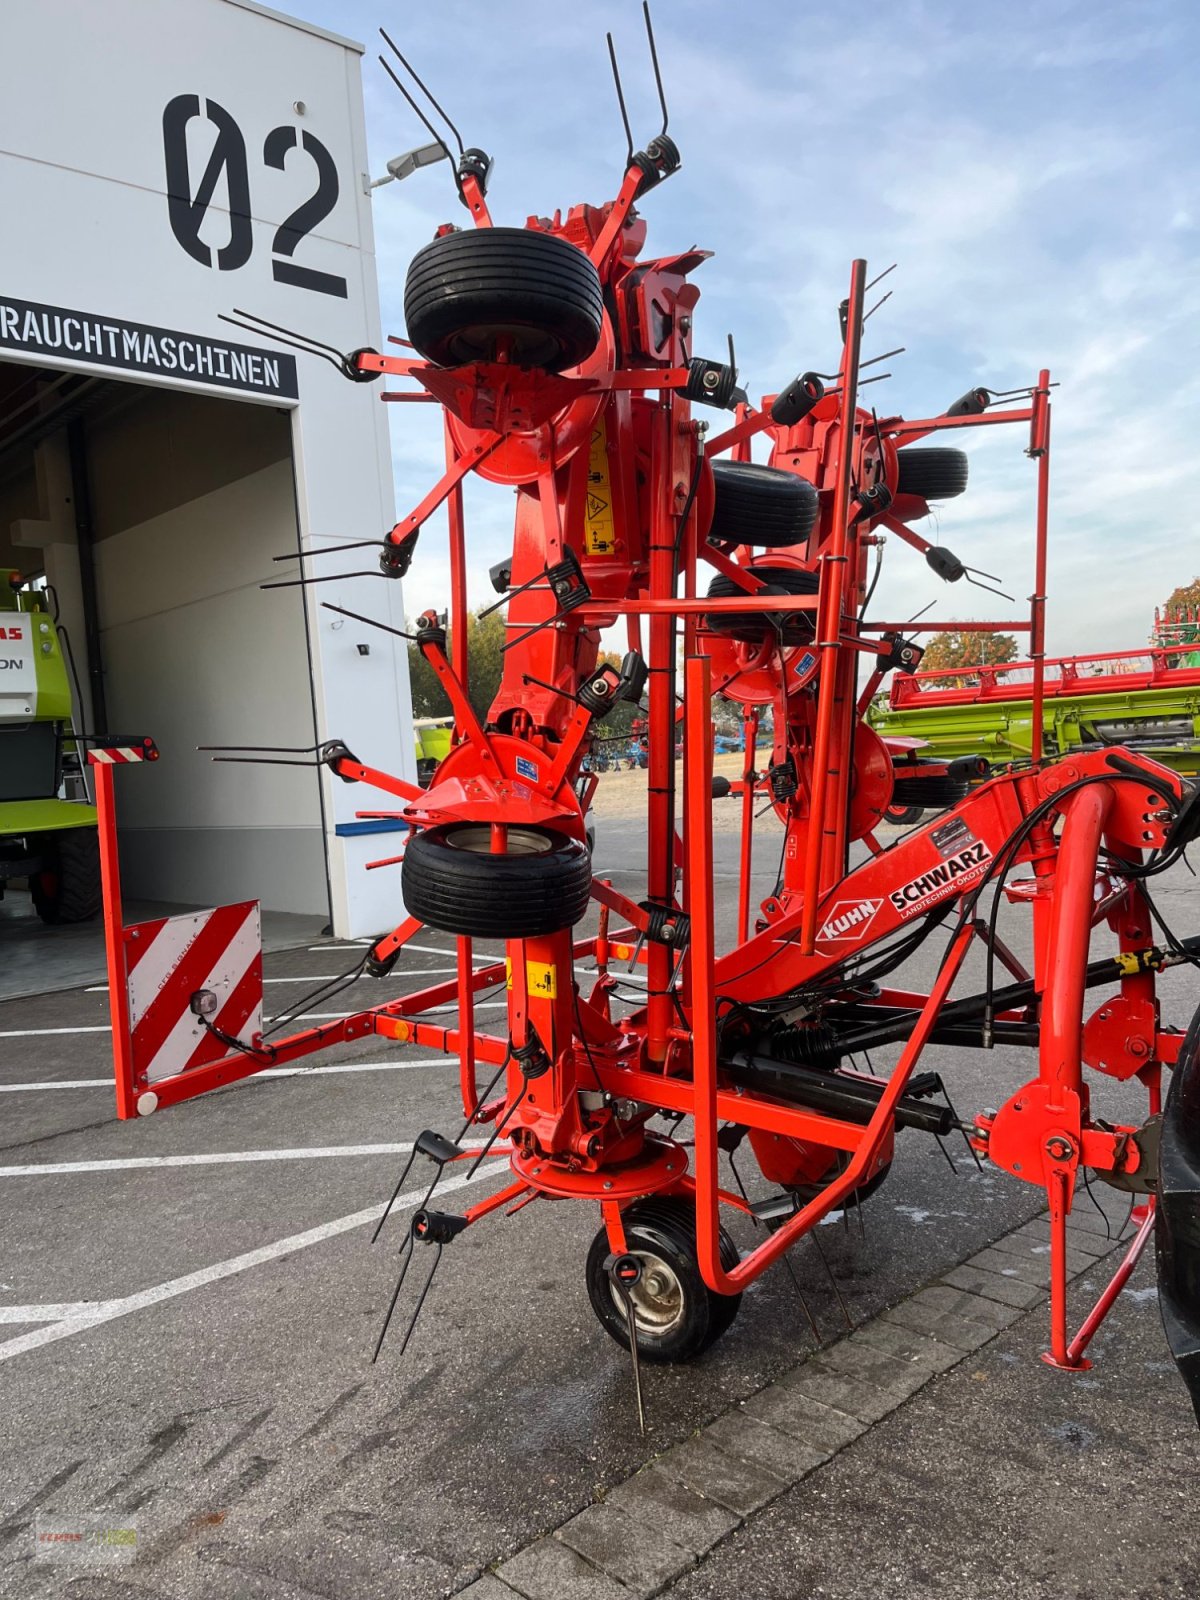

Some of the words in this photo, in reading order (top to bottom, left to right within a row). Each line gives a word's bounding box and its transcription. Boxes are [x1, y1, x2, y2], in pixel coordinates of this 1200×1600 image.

[163, 93, 348, 299] 02
[0, 305, 280, 389] RAUCHTMASCHINEN
[890, 843, 990, 910] SCHWARZ
[900, 884, 957, 920] LANDTECHNIK
[822, 900, 876, 939] KUHN
